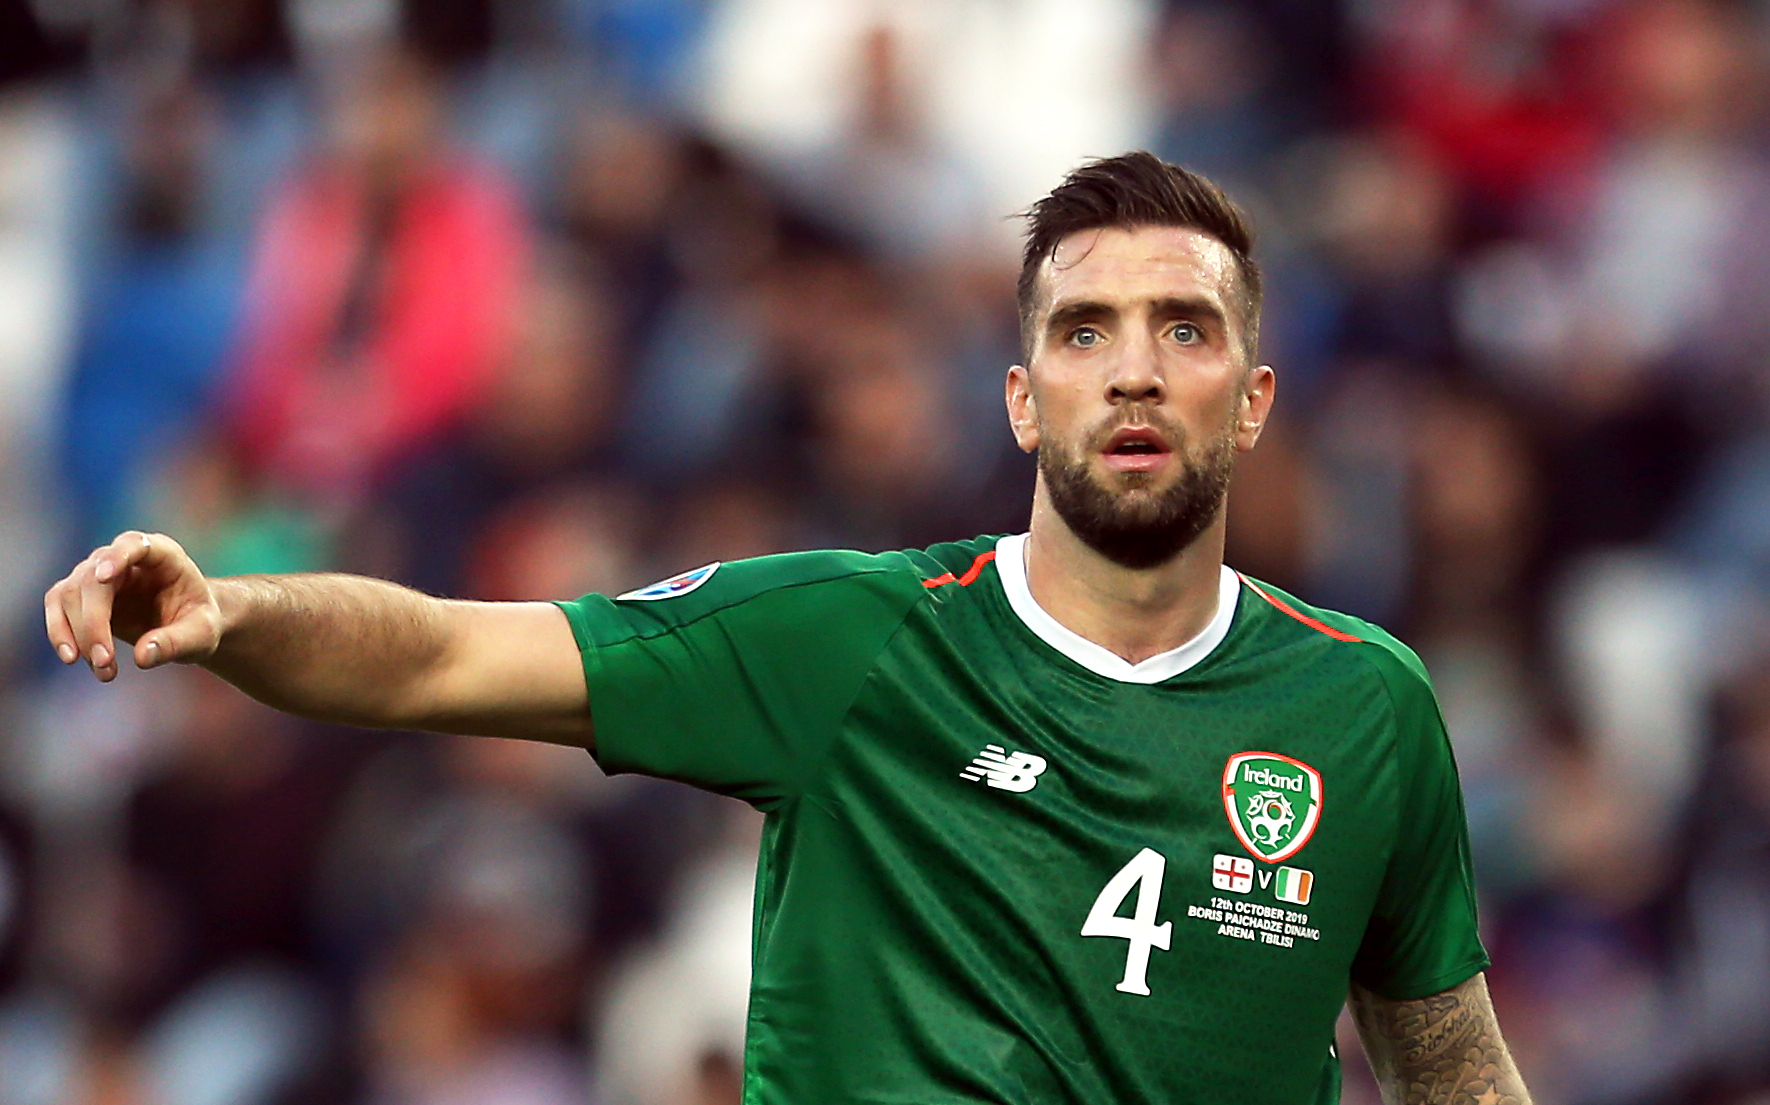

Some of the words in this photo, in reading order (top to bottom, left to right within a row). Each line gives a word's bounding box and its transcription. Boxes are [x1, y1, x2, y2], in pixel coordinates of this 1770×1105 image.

[1244, 763, 1304, 793] Ireland
[1080, 847, 1172, 996] 4
[1187, 905, 1223, 922] BORIS
[1224, 913, 1284, 933] PAICHADZE
[1284, 924, 1321, 941] DINAMO
[1210, 897, 1233, 911] 12th
[1234, 901, 1285, 921] OCTOBER
[1285, 910, 1308, 925] 2019
[1217, 924, 1255, 941] ARENA
[1259, 931, 1294, 949] TBILISI
